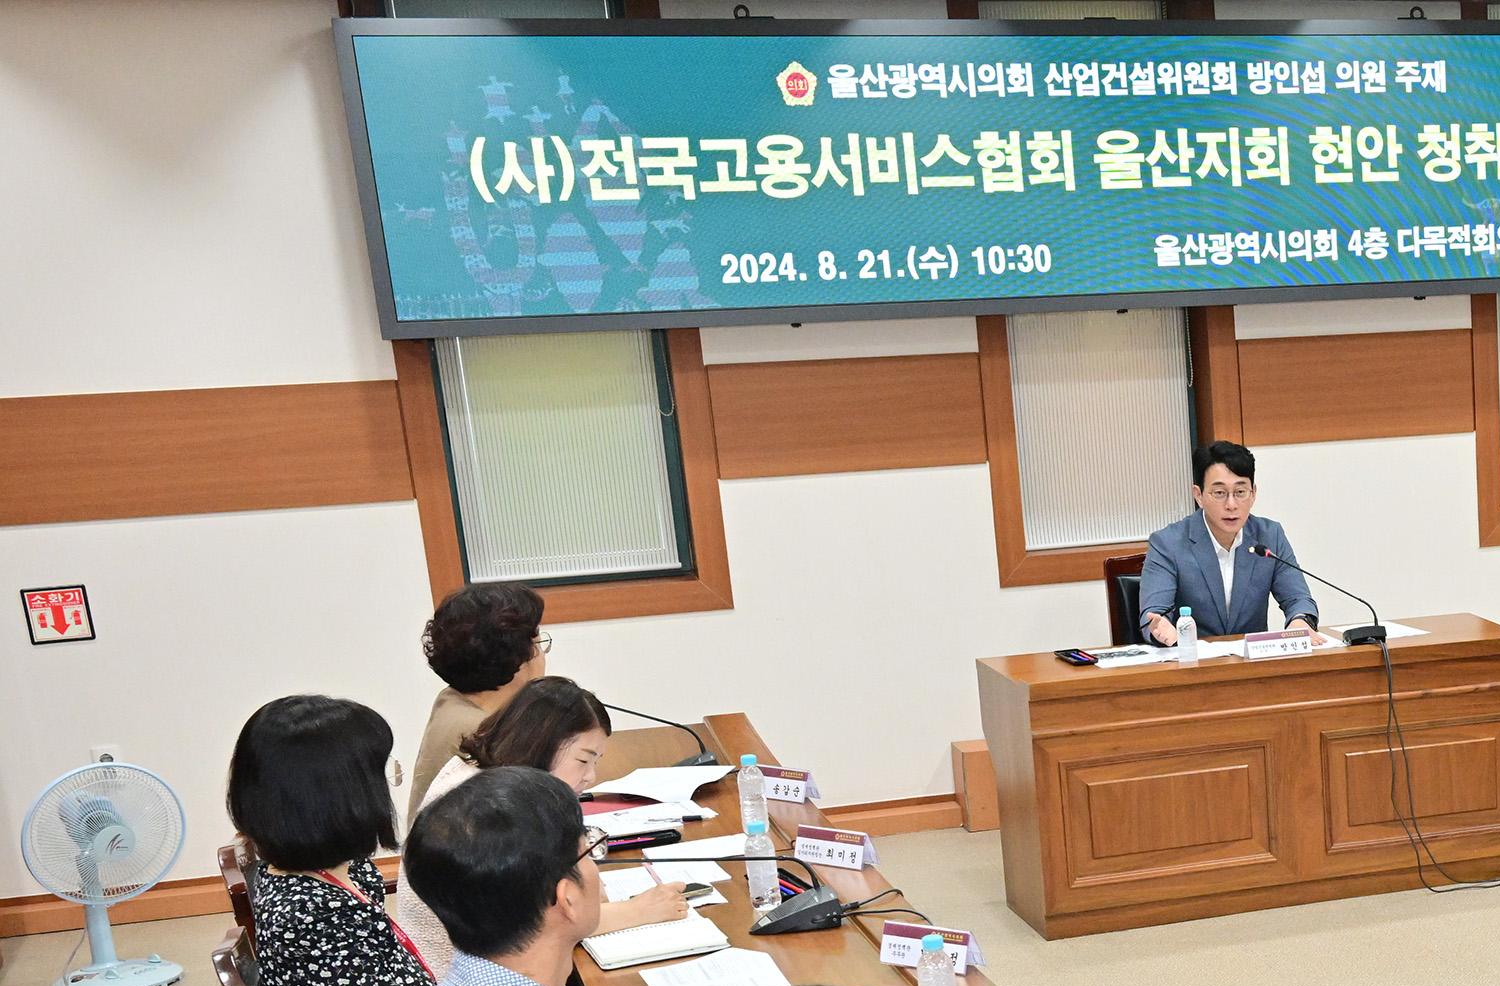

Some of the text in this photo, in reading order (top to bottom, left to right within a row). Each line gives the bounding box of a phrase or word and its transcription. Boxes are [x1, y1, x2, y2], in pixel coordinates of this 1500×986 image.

[827, 59, 1447, 99] 울산광역시의회 산업건설위원회 방인섭 의원 주재
[469, 129, 1076, 204] (사)전국고용서비스협회
[1093, 126, 1291, 190] 울산지회
[1308, 124, 1403, 184] 현안
[720, 244, 1052, 284] 2024. 8. 21.(수) 10:30
[1153, 228, 1339, 267] 울산광역시의회
[1347, 226, 1390, 260] 4층
[31, 591, 80, 605] 소화기
